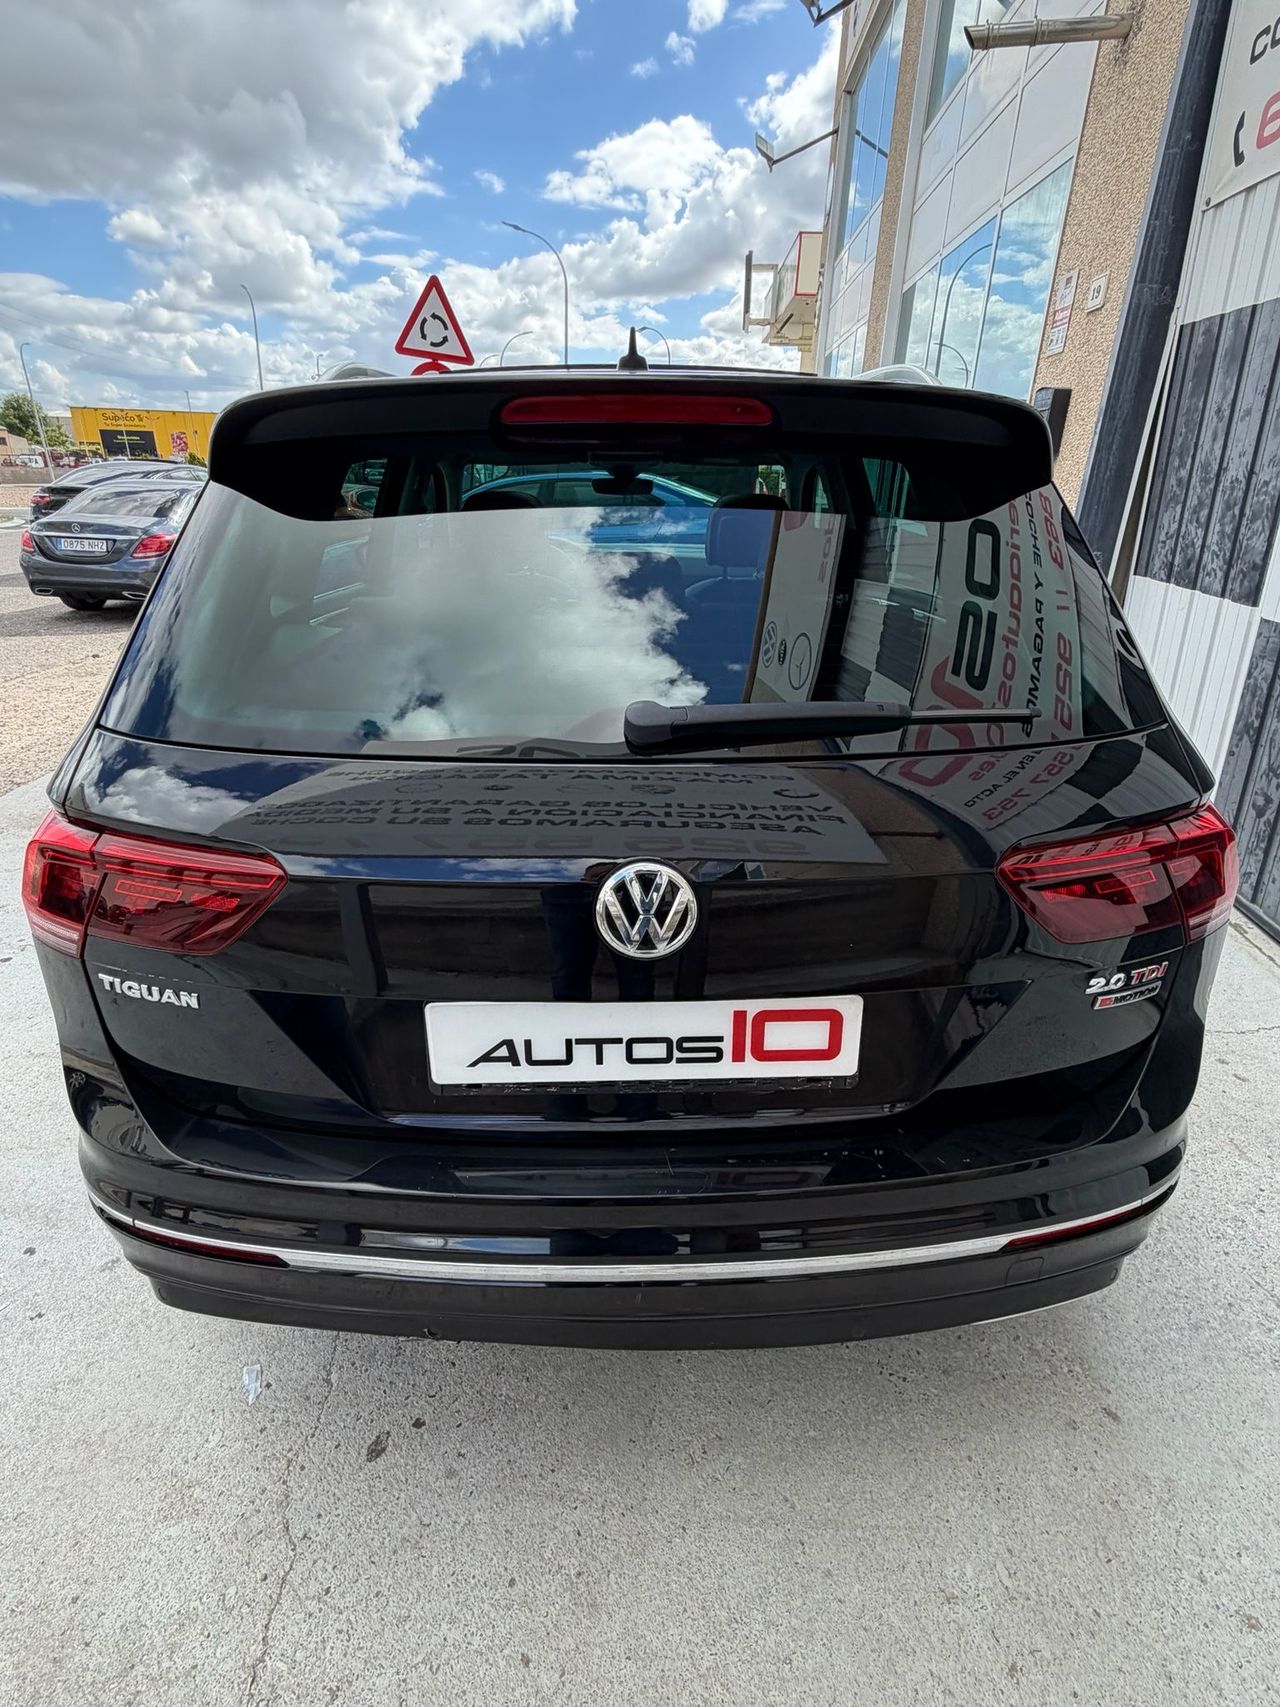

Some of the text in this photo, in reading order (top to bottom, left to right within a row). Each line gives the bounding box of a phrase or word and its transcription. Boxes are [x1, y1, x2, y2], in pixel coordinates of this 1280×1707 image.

[1090, 284, 1102, 301] 19
[63, 539, 86, 550] 0875
[1130, 961, 1168, 985] TDI
[98, 973, 199, 1009] TIGUAN
[466, 1008, 843, 1068] AUTOS10
